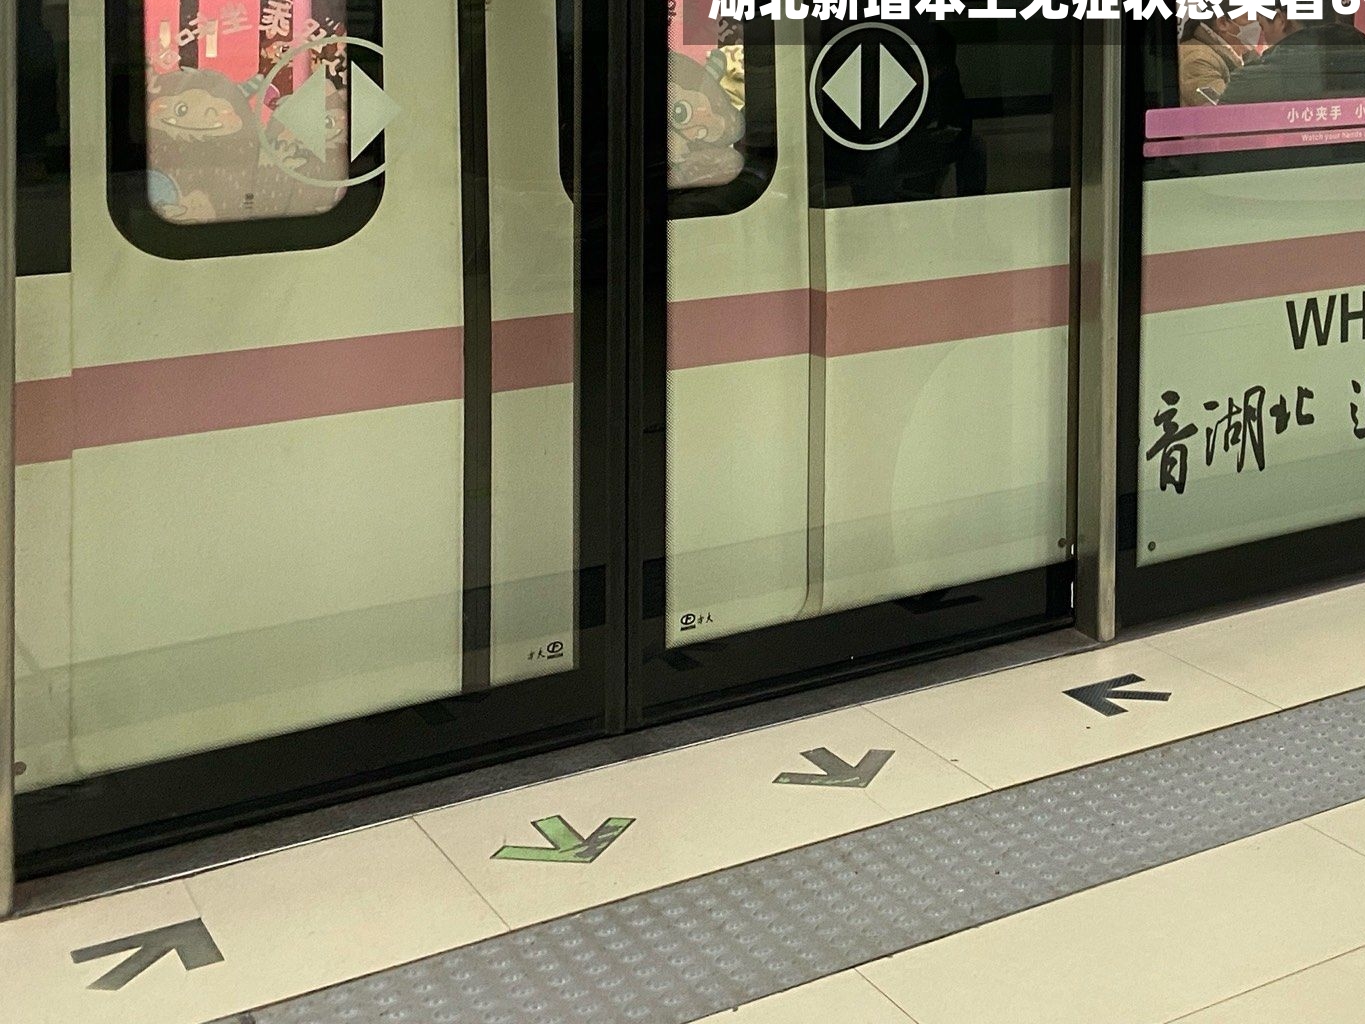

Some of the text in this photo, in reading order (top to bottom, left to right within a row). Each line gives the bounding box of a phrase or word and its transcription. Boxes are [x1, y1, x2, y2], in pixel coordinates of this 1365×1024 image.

[1287, 105, 1342, 124] 小心夹手
[1301, 133, 1323, 142] Watch
[1145, 385, 1316, 495] 音湖北
